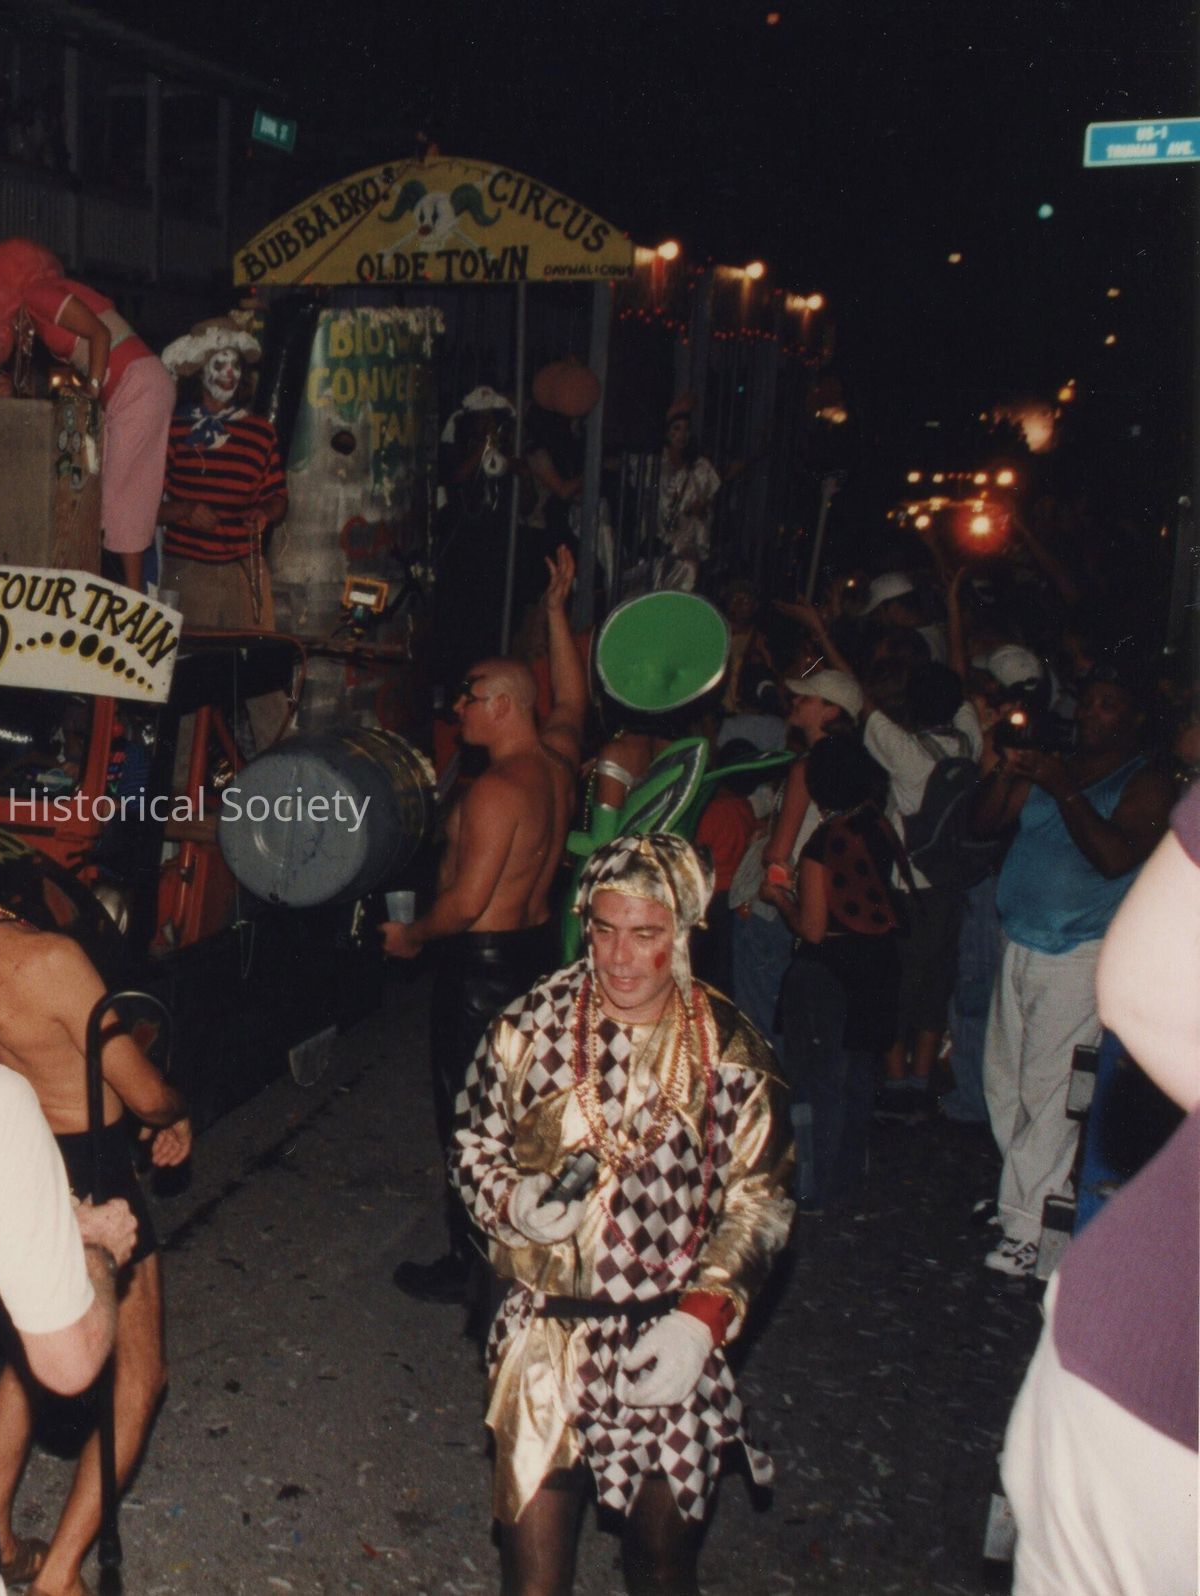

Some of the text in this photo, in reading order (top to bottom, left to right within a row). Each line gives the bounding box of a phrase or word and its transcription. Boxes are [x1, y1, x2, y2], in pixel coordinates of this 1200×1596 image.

[487, 172, 610, 252] CIRCUS
[356, 246, 529, 282] OLDE TOWN
[80, 583, 180, 669] TRAIN
